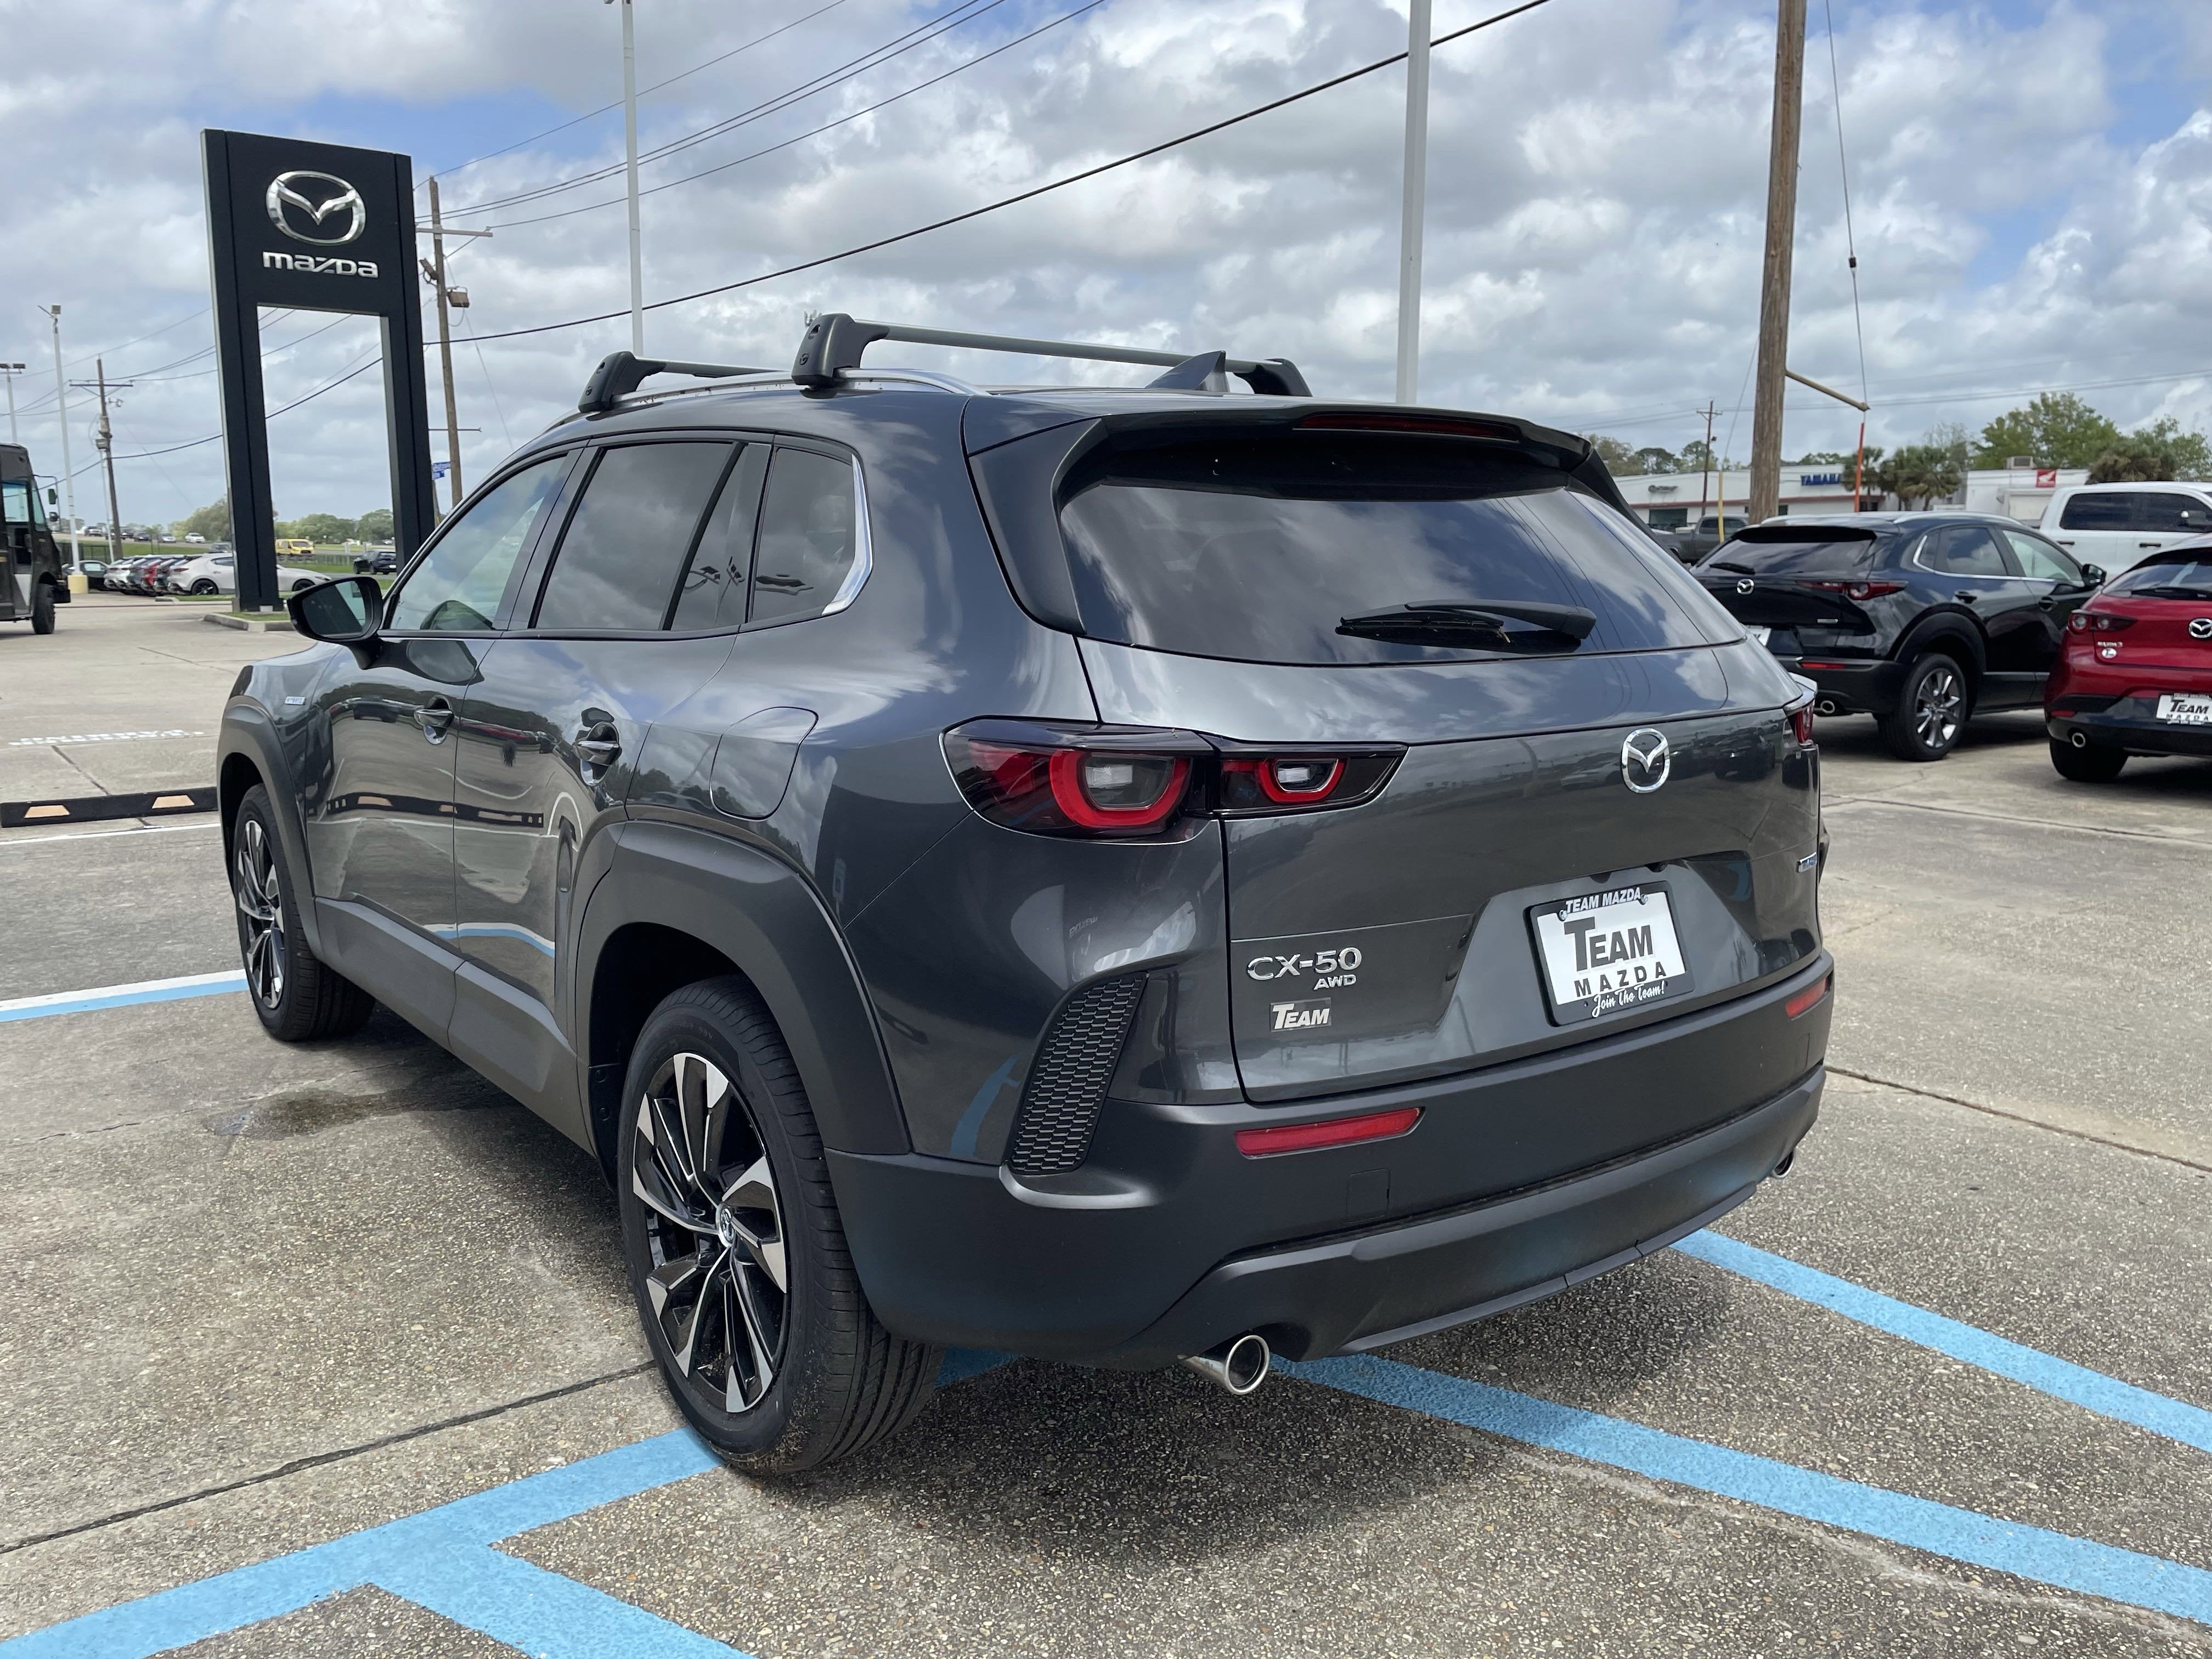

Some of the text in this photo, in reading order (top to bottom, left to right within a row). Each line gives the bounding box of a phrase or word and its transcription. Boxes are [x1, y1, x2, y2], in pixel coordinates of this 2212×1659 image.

[2171, 699, 2209, 714] TEAM
[1566, 887, 1641, 913] TEAM MAZDA
[1564, 916, 1654, 972] TEAM
[1247, 947, 1362, 981] CX-50
[1574, 961, 1667, 997] MAZDA
[1313, 974, 1357, 990] AWD
[1592, 980, 1665, 1018] Join The Team!
[1272, 1003, 1330, 1030] TEAM
